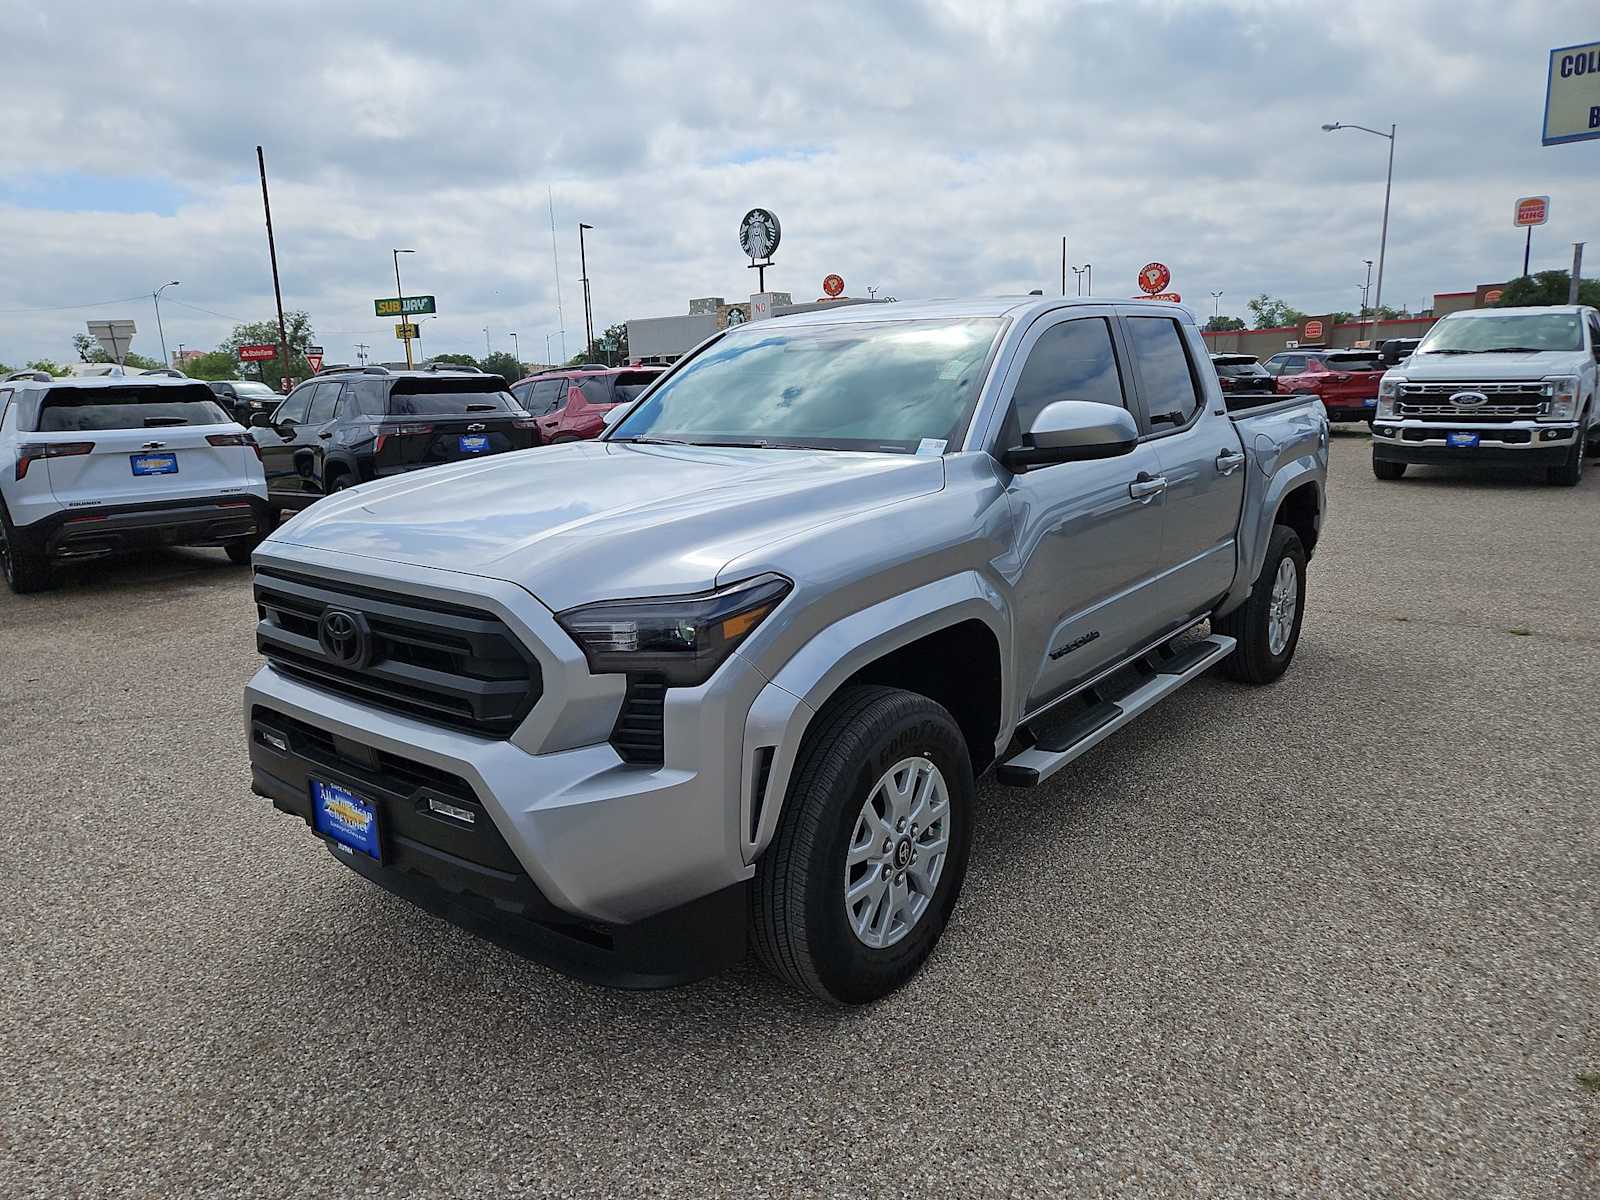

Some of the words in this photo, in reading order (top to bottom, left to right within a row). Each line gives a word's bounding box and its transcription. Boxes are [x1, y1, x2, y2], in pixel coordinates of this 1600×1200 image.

[1560, 51, 1600, 79] COL
[1519, 210, 1545, 220] KING
[755, 303, 766, 313] NO
